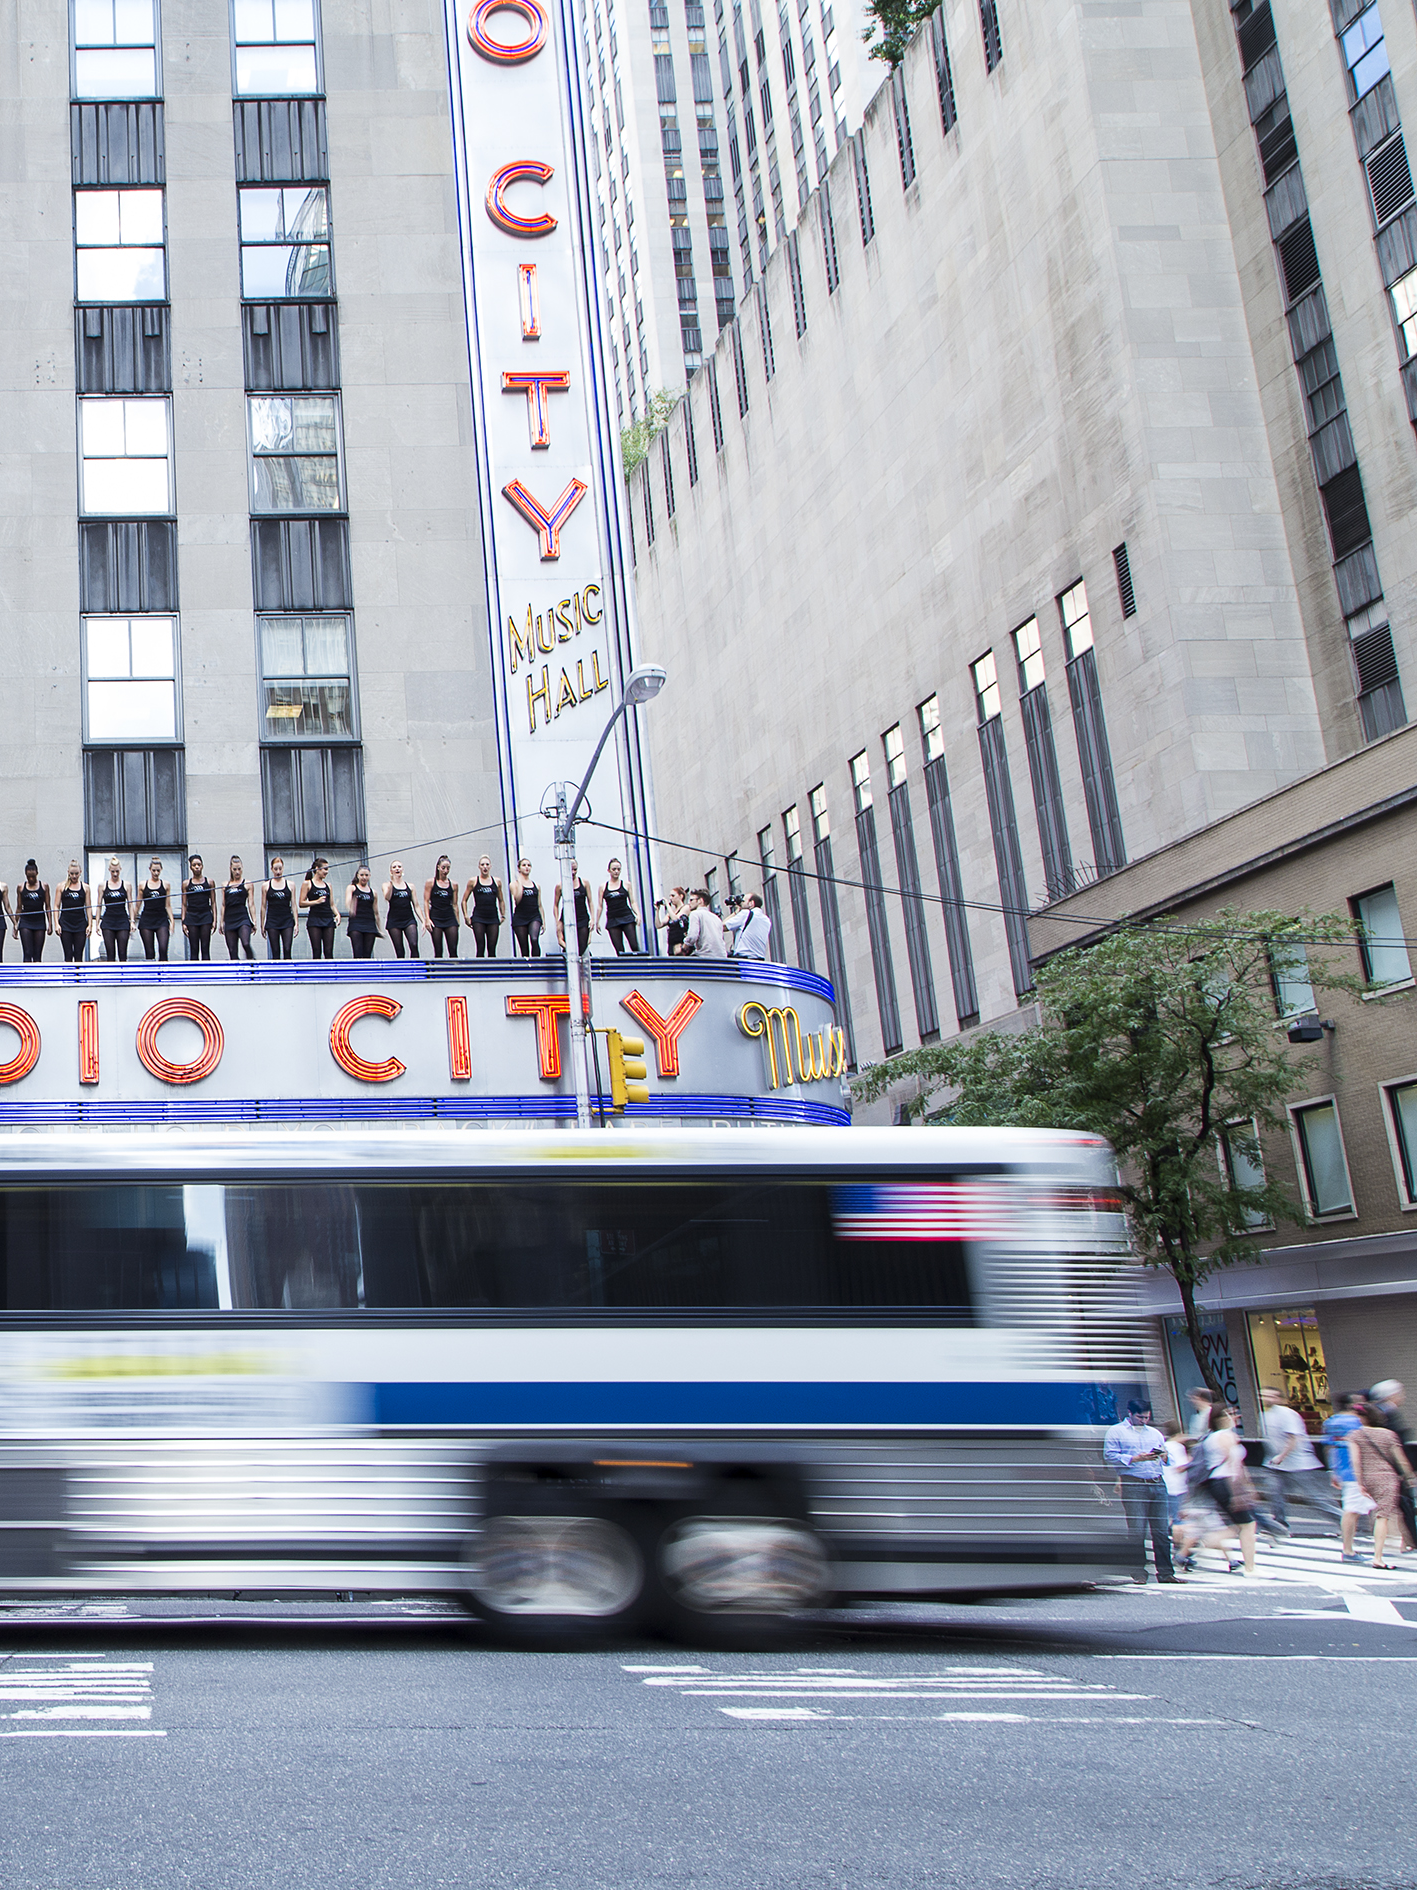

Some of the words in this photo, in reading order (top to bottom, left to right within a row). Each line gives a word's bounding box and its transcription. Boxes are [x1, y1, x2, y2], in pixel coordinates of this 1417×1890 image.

[484, 160, 588, 562] CITY
[507, 584, 603, 674] MUSIC
[525, 650, 609, 734] HALL
[328, 988, 704, 1084] CITY
[735, 1001, 847, 1091] Mus
